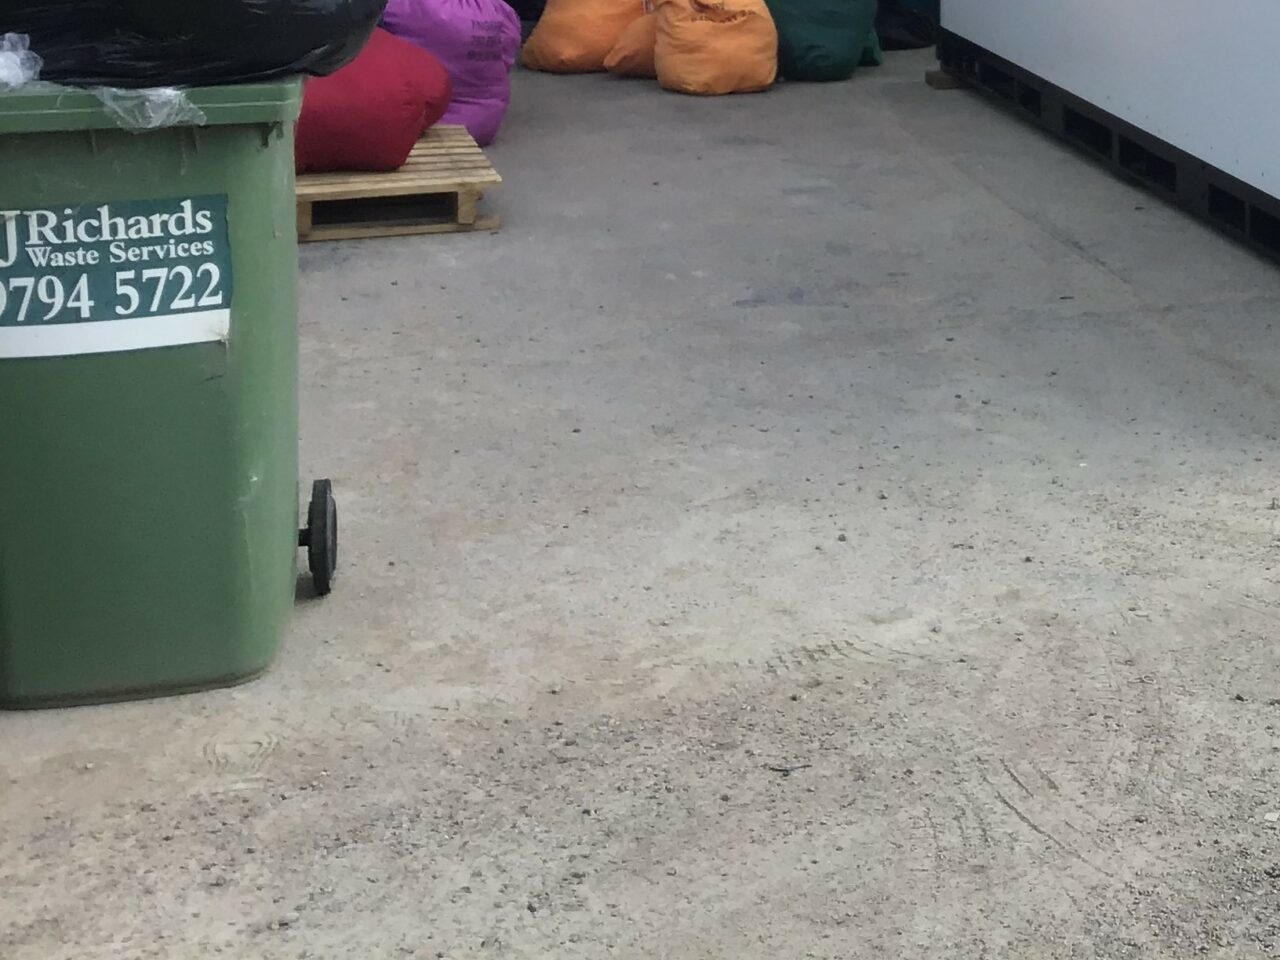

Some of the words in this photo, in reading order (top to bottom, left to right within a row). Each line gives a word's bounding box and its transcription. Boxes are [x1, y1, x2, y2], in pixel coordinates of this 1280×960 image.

[23, 198, 213, 246] Richards
[25, 246, 100, 268] Waste
[109, 239, 215, 264] Services
[115, 262, 223, 315] 5722
